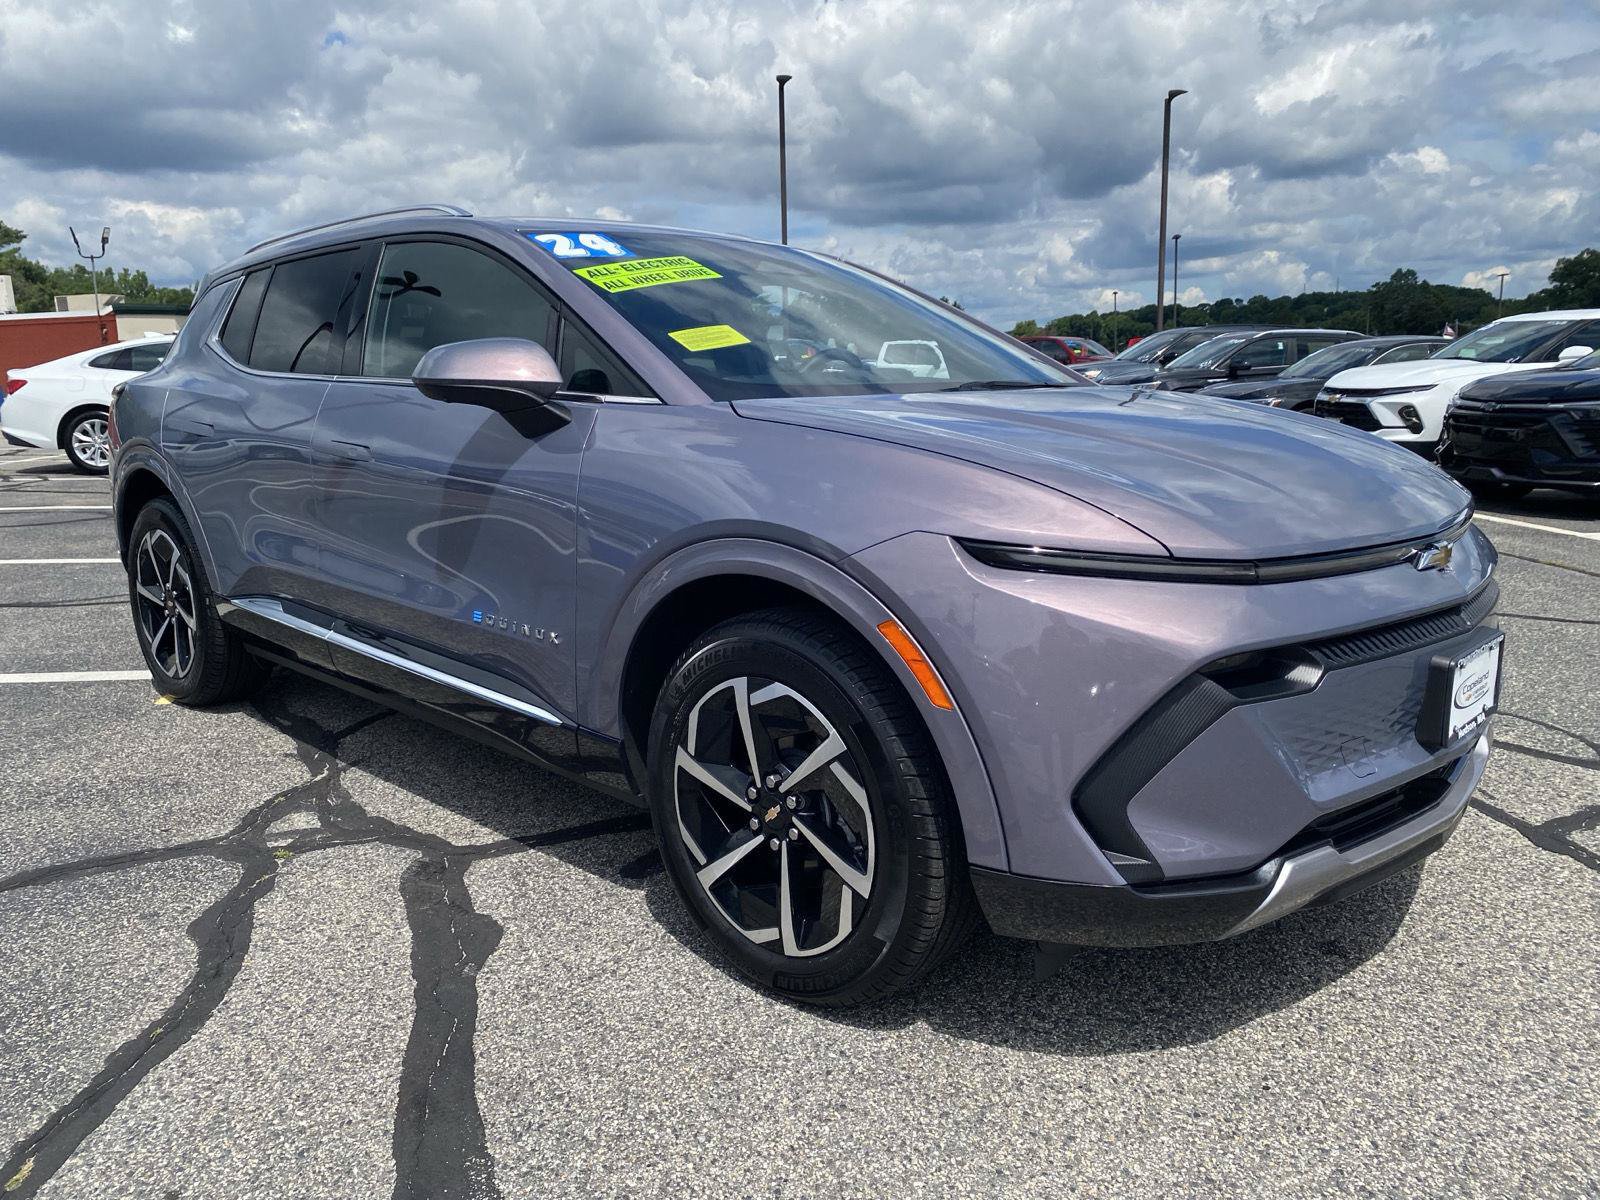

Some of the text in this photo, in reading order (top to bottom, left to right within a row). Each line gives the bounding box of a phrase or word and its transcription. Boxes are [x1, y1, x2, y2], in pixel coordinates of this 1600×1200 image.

[534, 233, 627, 257] 24
[603, 268, 712, 291] ALL WHEEL DRIVE
[473, 610, 561, 645] EQUINOX
